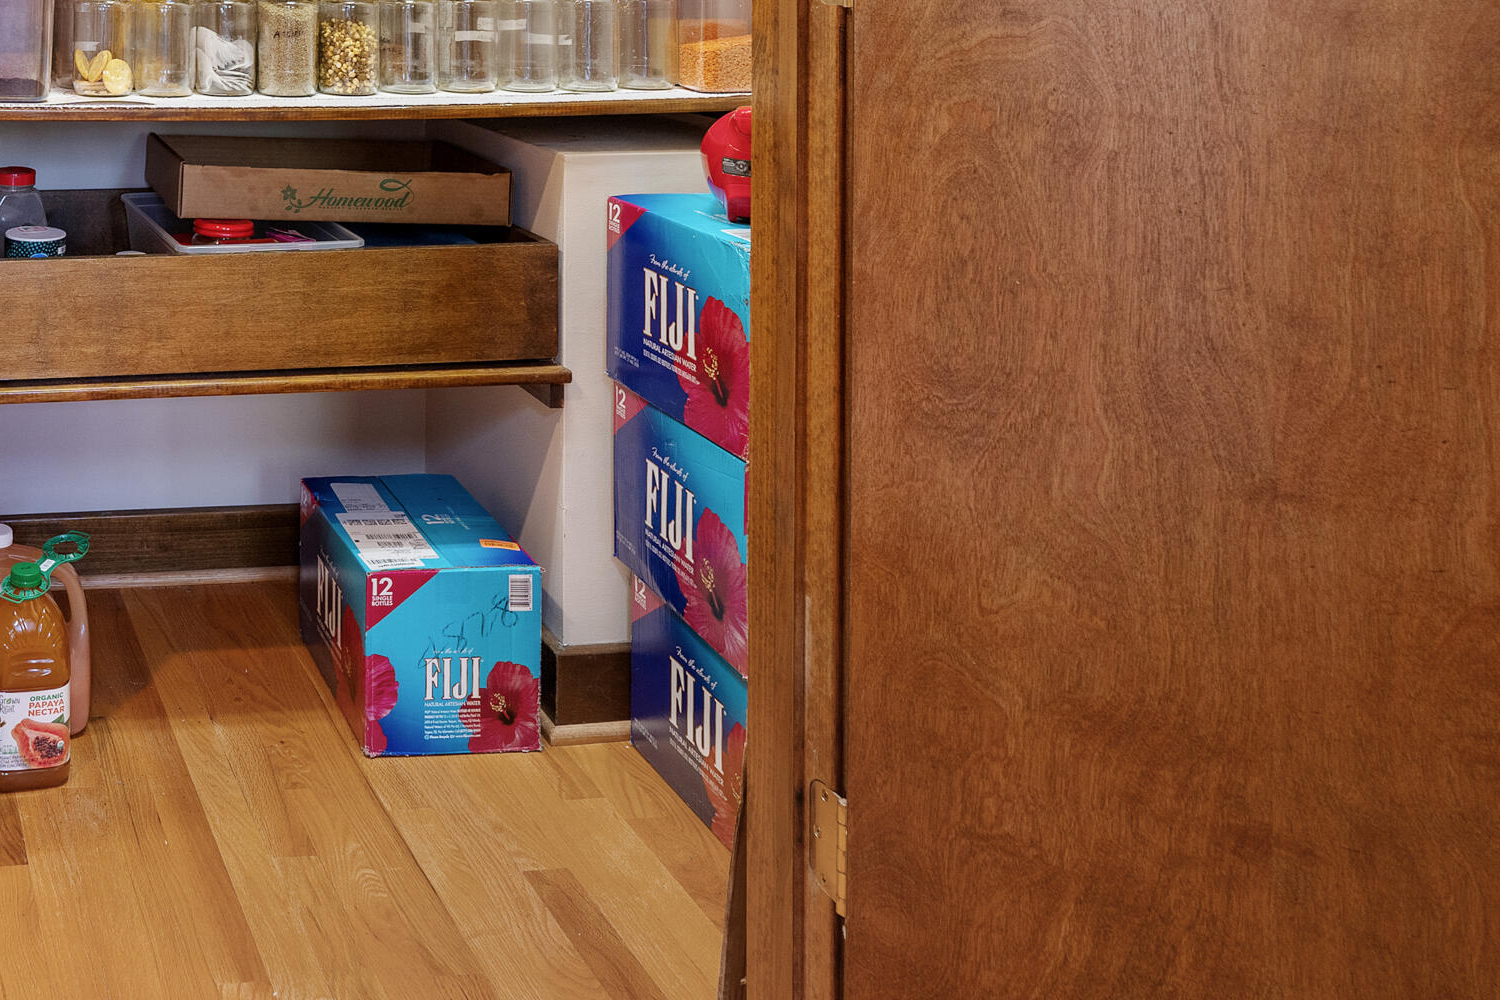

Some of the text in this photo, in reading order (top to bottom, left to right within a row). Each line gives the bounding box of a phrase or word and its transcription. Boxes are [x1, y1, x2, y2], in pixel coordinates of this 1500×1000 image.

[309, 188, 411, 208] Homewood
[609, 203, 621, 224] 12
[643, 267, 697, 361] FIJI
[643, 337, 661, 353] NATURAL
[681, 357, 697, 373] WATER
[615, 386, 626, 409] 12
[645, 458, 695, 564] FIJI
[645, 528, 661, 548] NATURAL
[680, 556, 694, 575] WATER
[371, 577, 393, 596] 12
[634, 574, 646, 601] 12
[317, 554, 342, 652] FIJI
[424, 656, 482, 700] FIJI
[27, 706, 65, 717] NECTAR
[28, 699, 65, 709] PAPAYA
[29, 692, 64, 702] ORGANIC
[669, 655, 725, 775] FIJI
[669, 726, 687, 751] NATURAL
[708, 766, 725, 788] WATER
